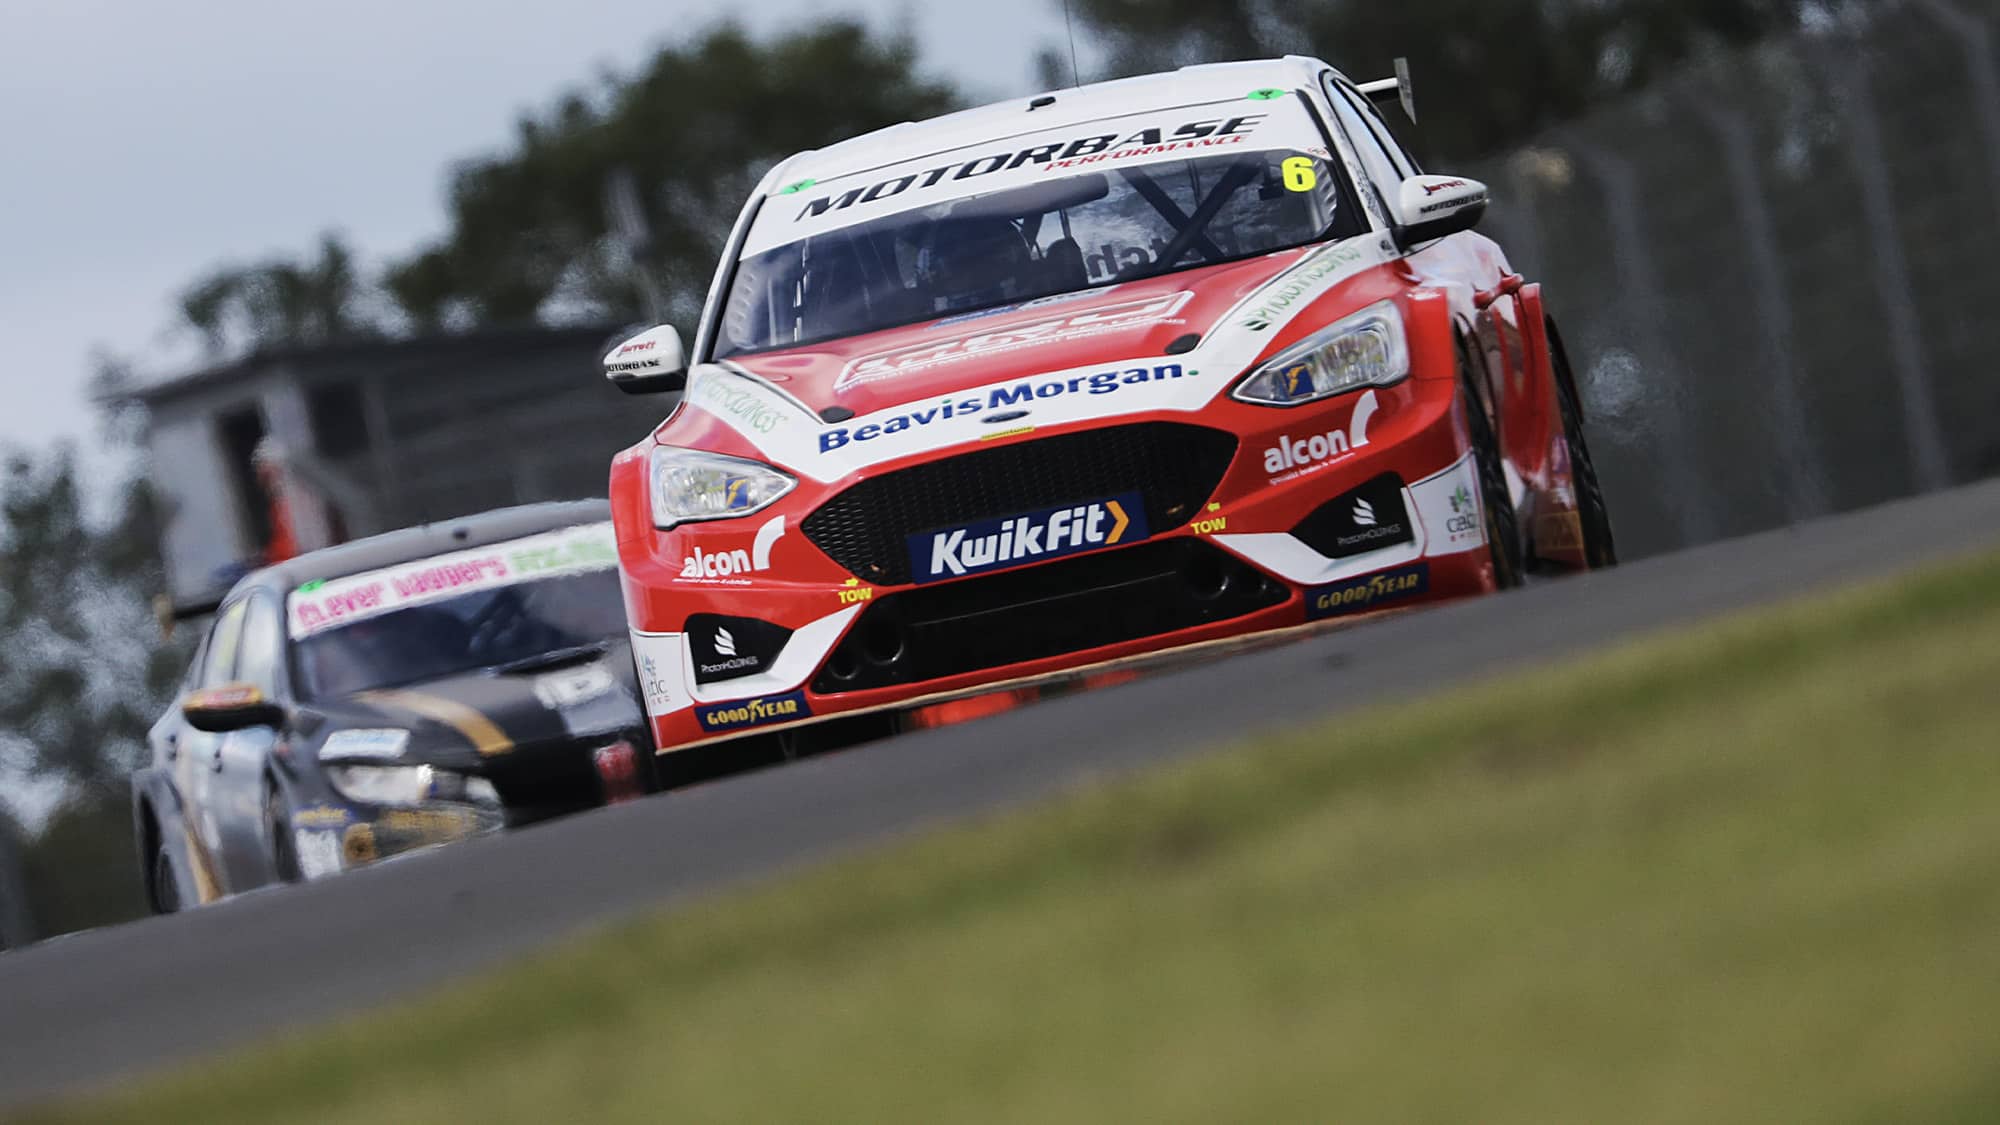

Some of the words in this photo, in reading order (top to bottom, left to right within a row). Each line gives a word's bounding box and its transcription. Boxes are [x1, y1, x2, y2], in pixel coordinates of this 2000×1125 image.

[794, 113, 1268, 223] MOTORBASE
[1043, 134, 1248, 172] PERFORMANCE
[1281, 156, 1317, 192] 6
[1264, 428, 1349, 474] alcon
[1191, 517, 1226, 535] TOW
[679, 546, 752, 578] alcon
[838, 586, 873, 604] TOW
[1316, 574, 1419, 609] GOODYEAR
[706, 699, 798, 726] GOODYEAR
